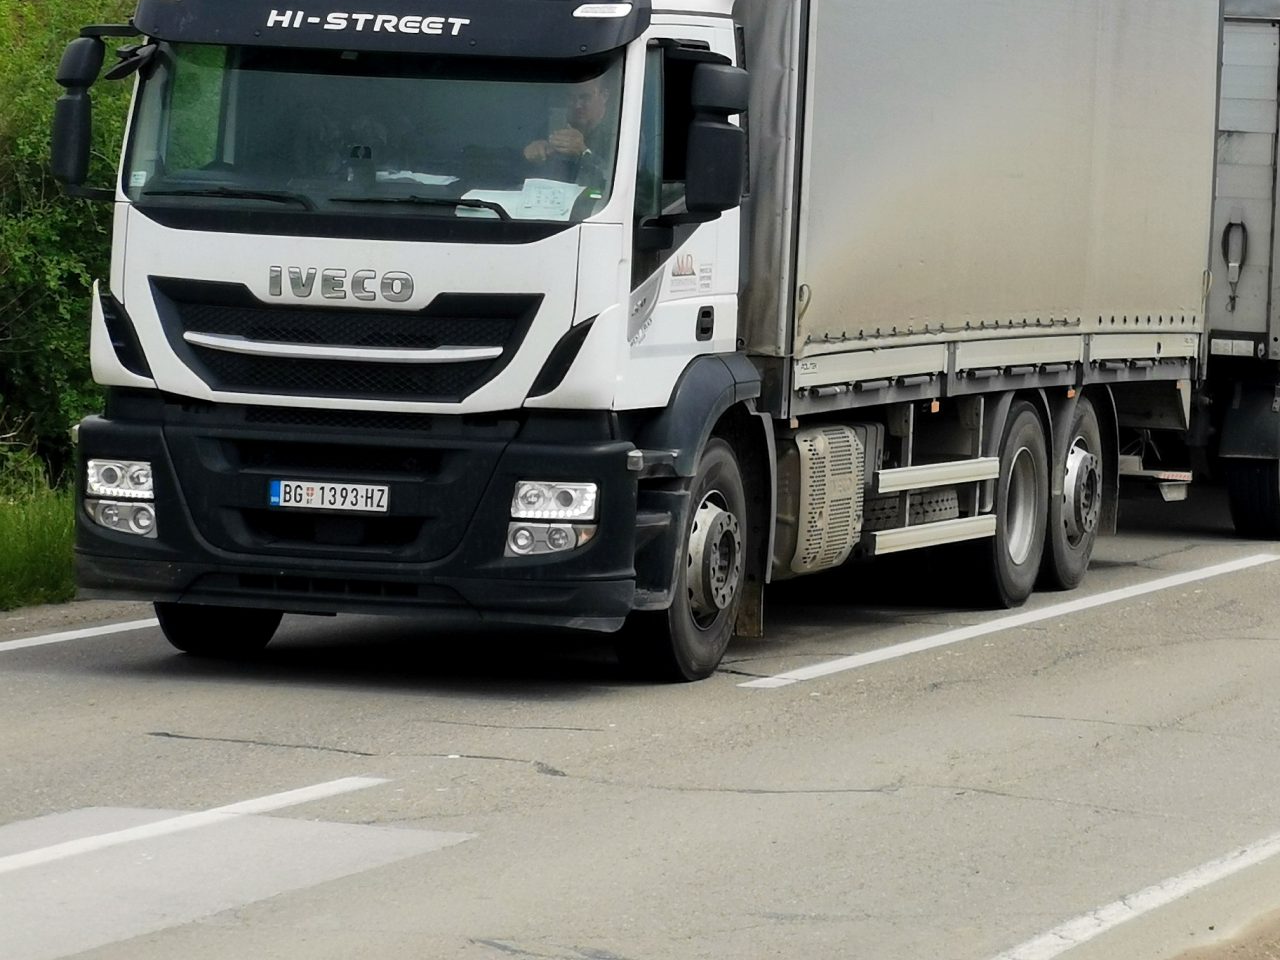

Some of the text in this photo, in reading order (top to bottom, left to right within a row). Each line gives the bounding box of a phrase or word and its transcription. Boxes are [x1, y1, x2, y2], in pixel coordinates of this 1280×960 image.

[266, 9, 471, 36] HI-STREET
[268, 265, 415, 303] IVECO
[283, 483, 304, 504] BG
